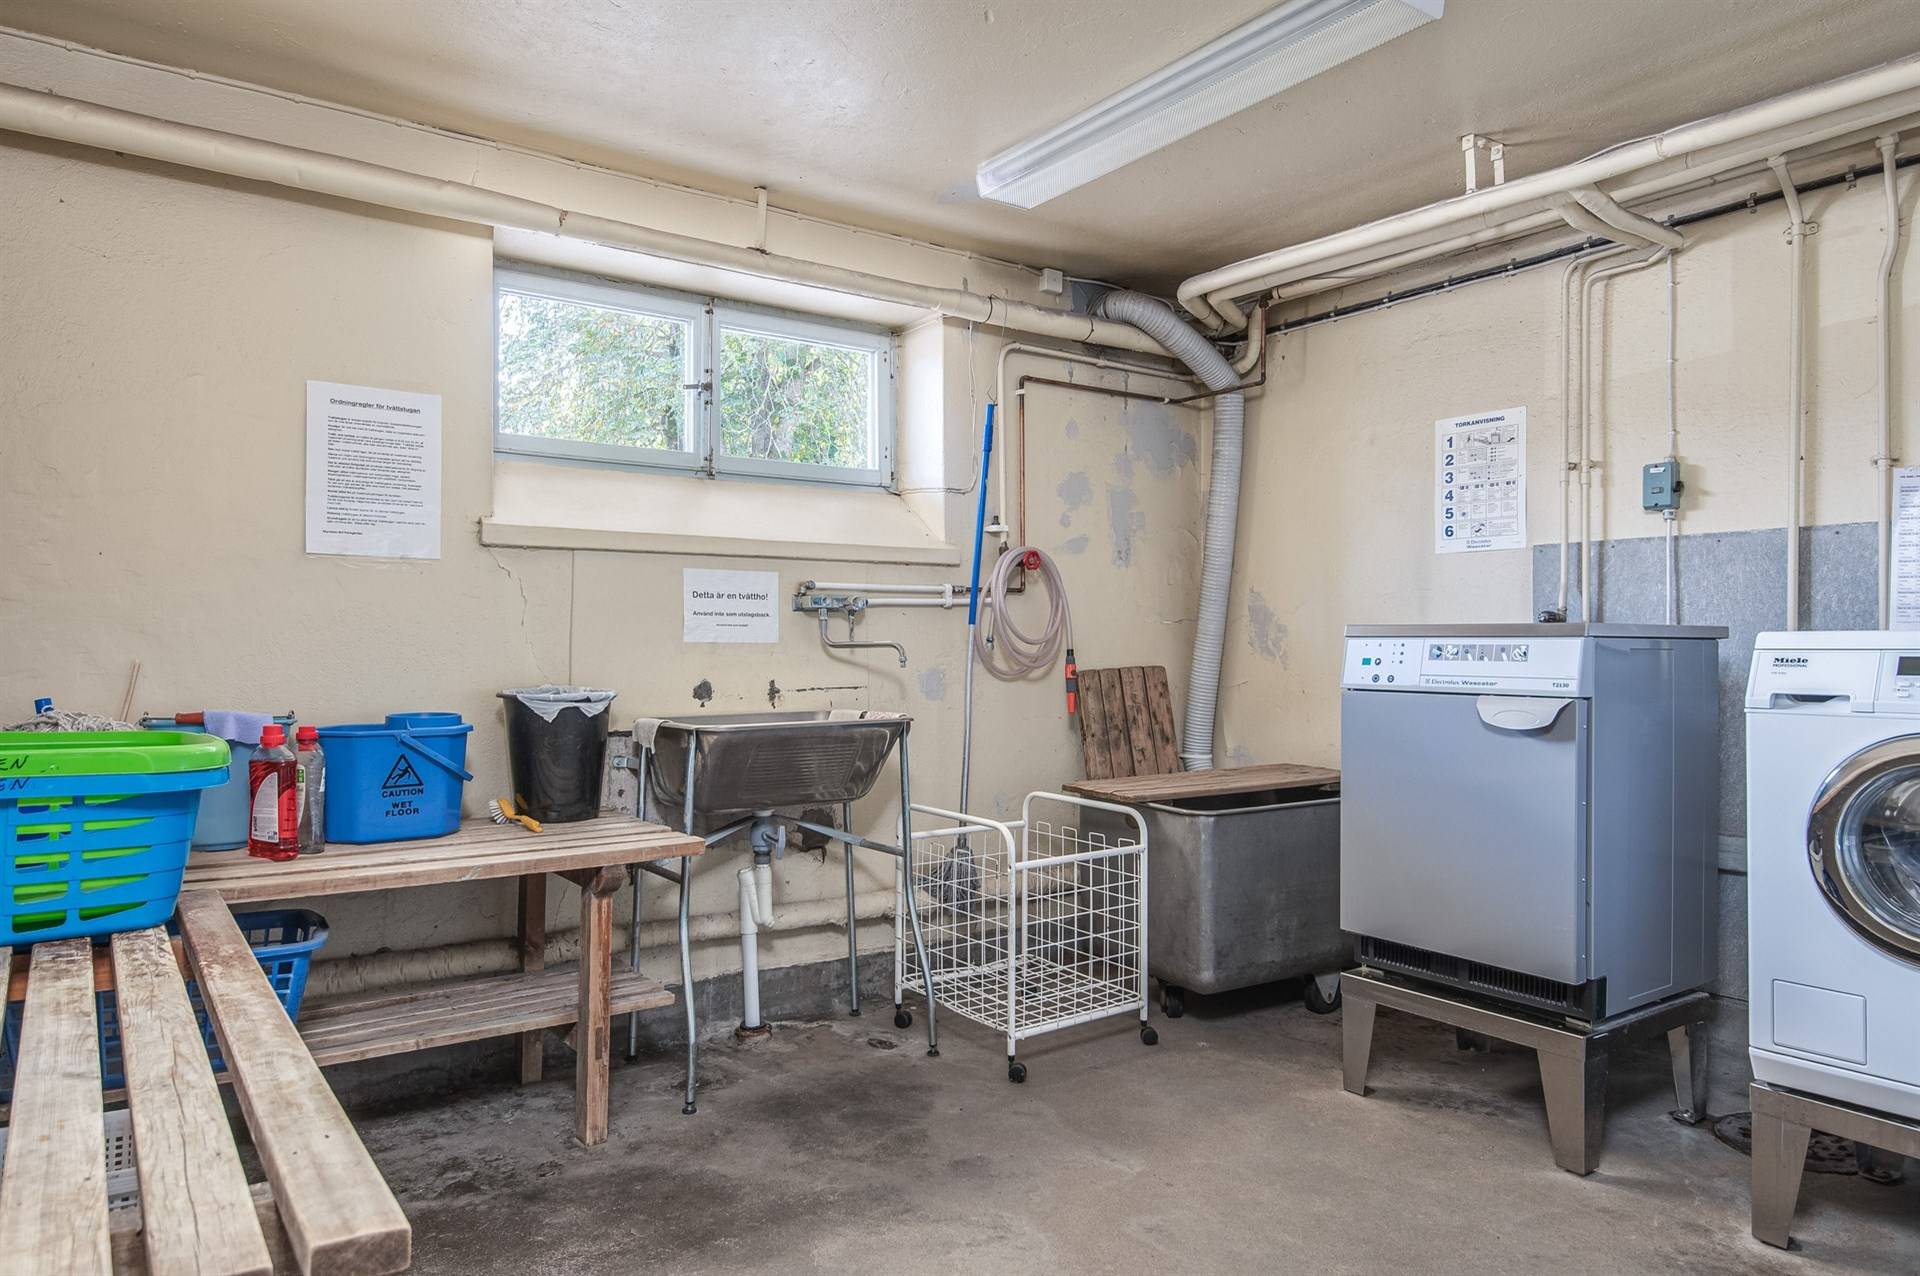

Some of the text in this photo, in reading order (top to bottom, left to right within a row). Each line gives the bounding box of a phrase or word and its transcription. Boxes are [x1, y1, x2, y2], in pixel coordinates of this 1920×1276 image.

[329, 398, 374, 408] Ordningregler
[386, 404, 421, 414] tvättstugan
[1455, 415, 1505, 428] TORKANVISNING
[1447, 436, 1453, 448] 1
[1445, 454, 1454, 466] 2
[1445, 472, 1454, 484] 3
[1445, 490, 1454, 501] 4
[1445, 507, 1454, 519] 5
[1445, 525, 1454, 537] 6
[692, 590, 715, 599] Detta
[739, 592, 769, 600] tvättho!
[382, 787, 424, 798] CAUTION
[391, 800, 413, 809] WET
[385, 808, 420, 817] FLOOR
